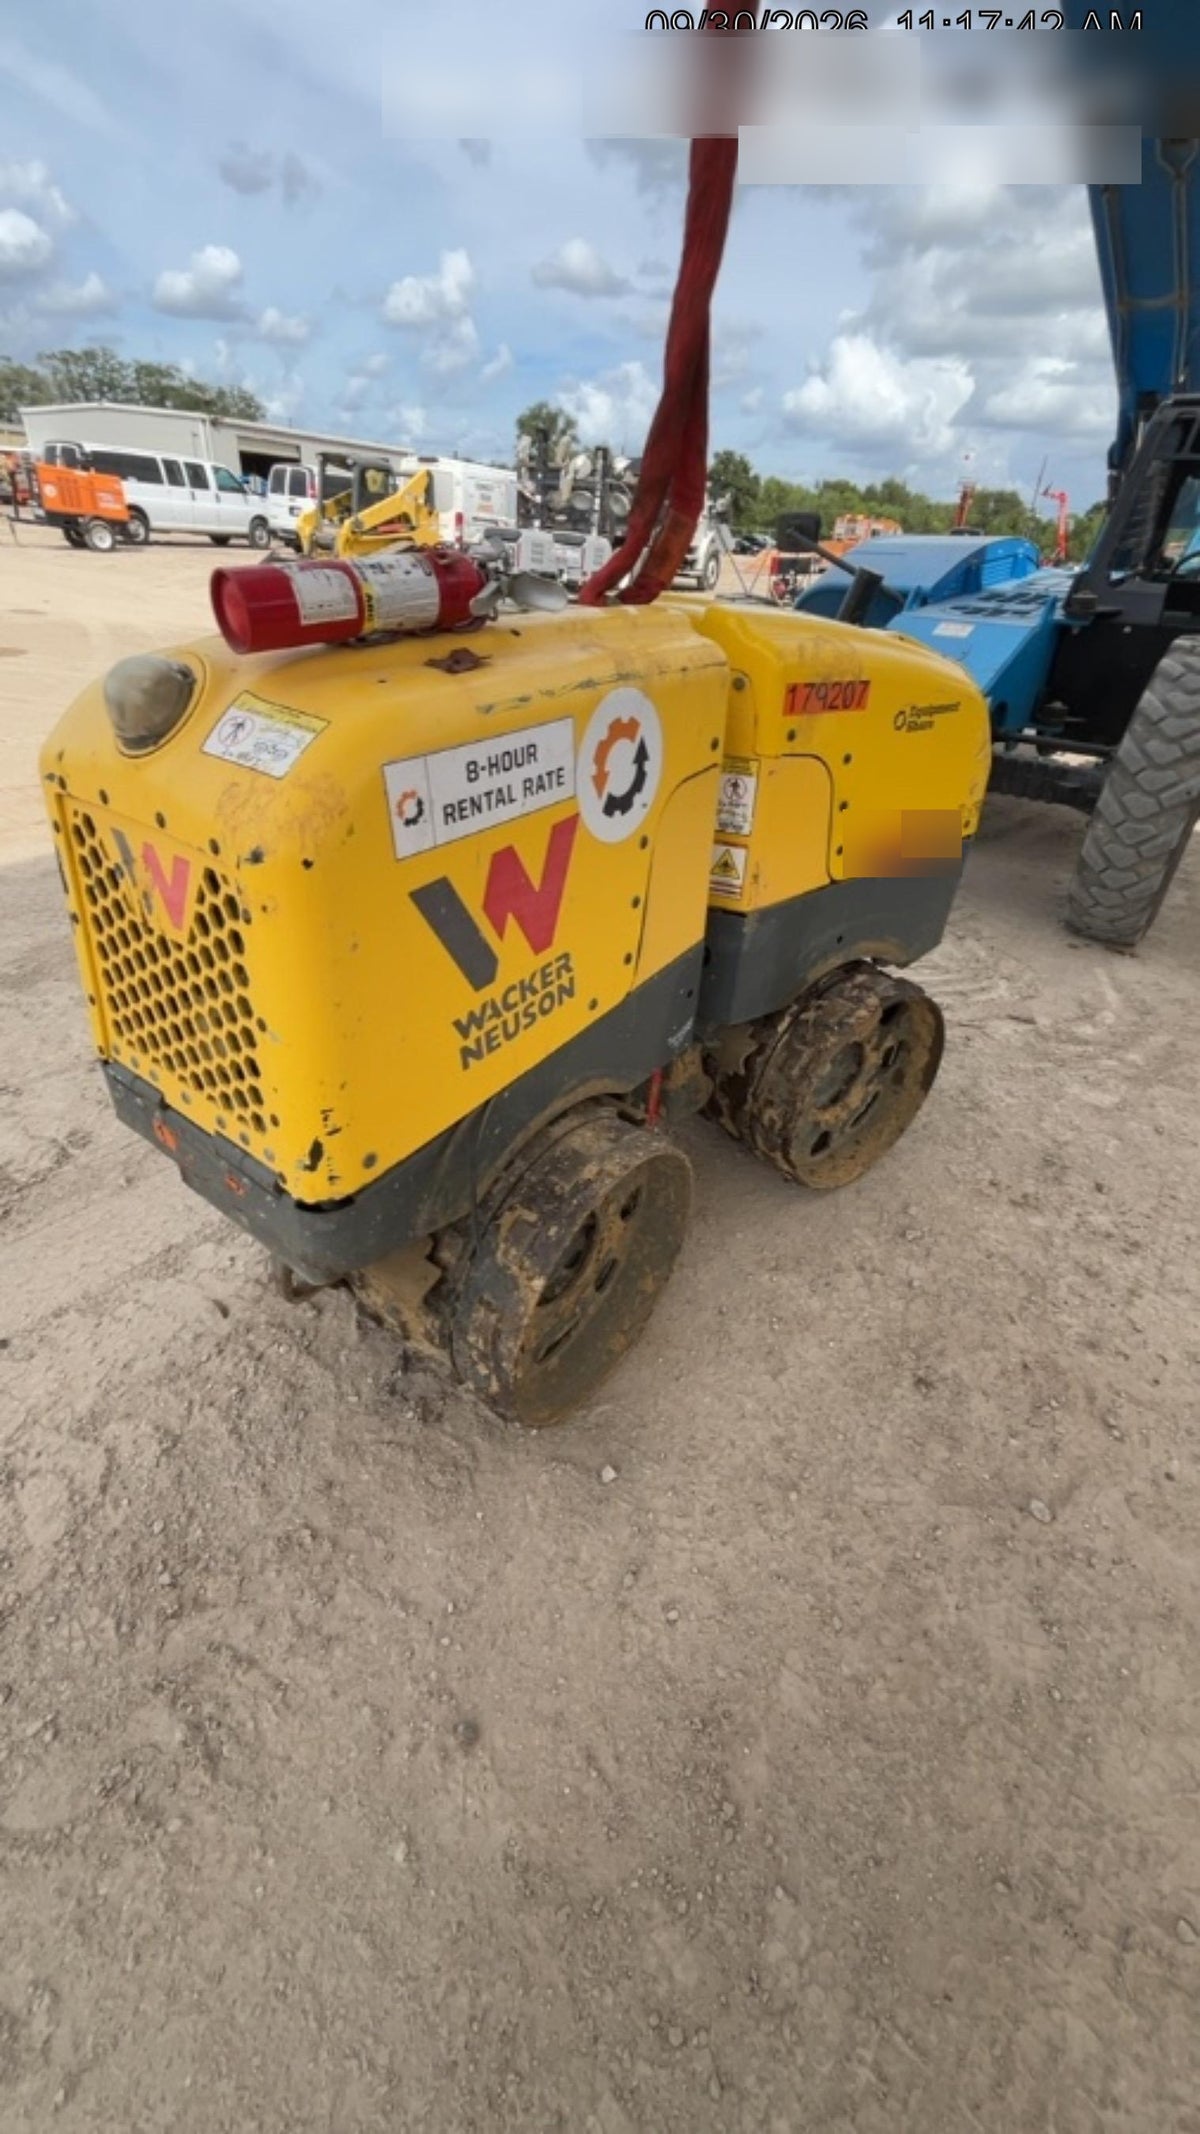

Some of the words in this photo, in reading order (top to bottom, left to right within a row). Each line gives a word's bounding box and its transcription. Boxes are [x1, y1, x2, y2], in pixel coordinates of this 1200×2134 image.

[787, 680, 870, 715] 179207
[466, 743, 538, 783] 8-HOUR
[443, 784, 517, 826] RENTAL
[522, 766, 566, 798] RATE
[452, 952, 574, 1040] WACKER
[459, 976, 575, 1071] NEUSON
